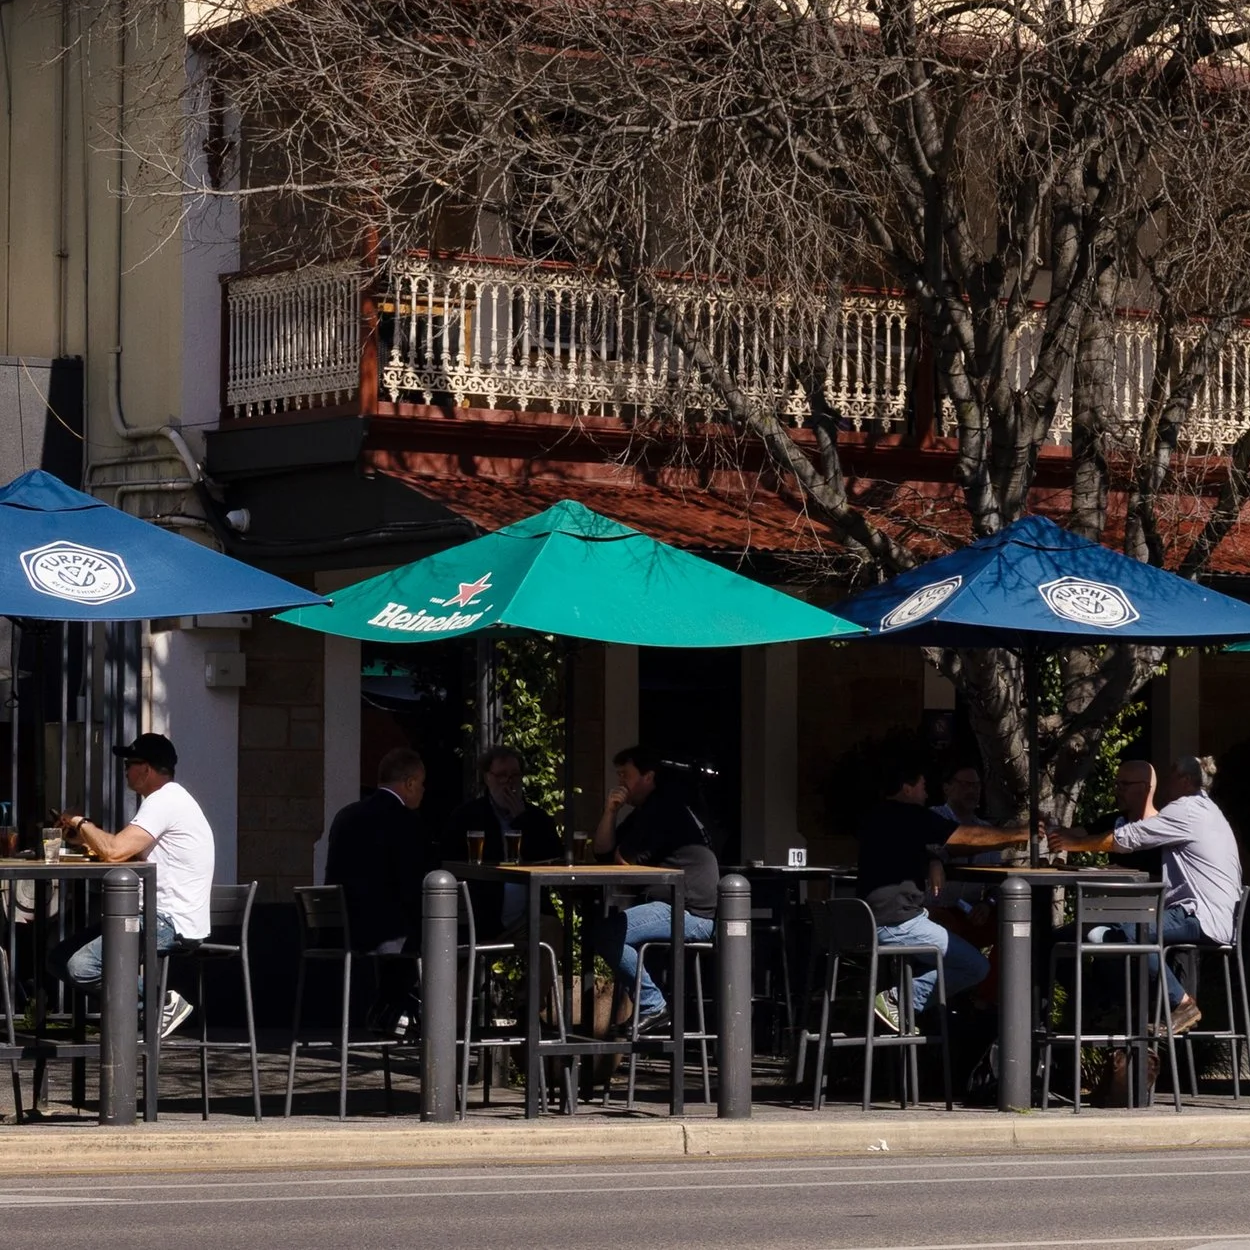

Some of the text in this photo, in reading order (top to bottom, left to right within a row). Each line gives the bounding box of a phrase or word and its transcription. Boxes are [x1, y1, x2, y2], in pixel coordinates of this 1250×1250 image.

[40, 555, 107, 572] FURPHY
[1056, 587, 1111, 602] FURPHY
[367, 602, 484, 632] Heineken
[792, 851, 803, 863] 10
